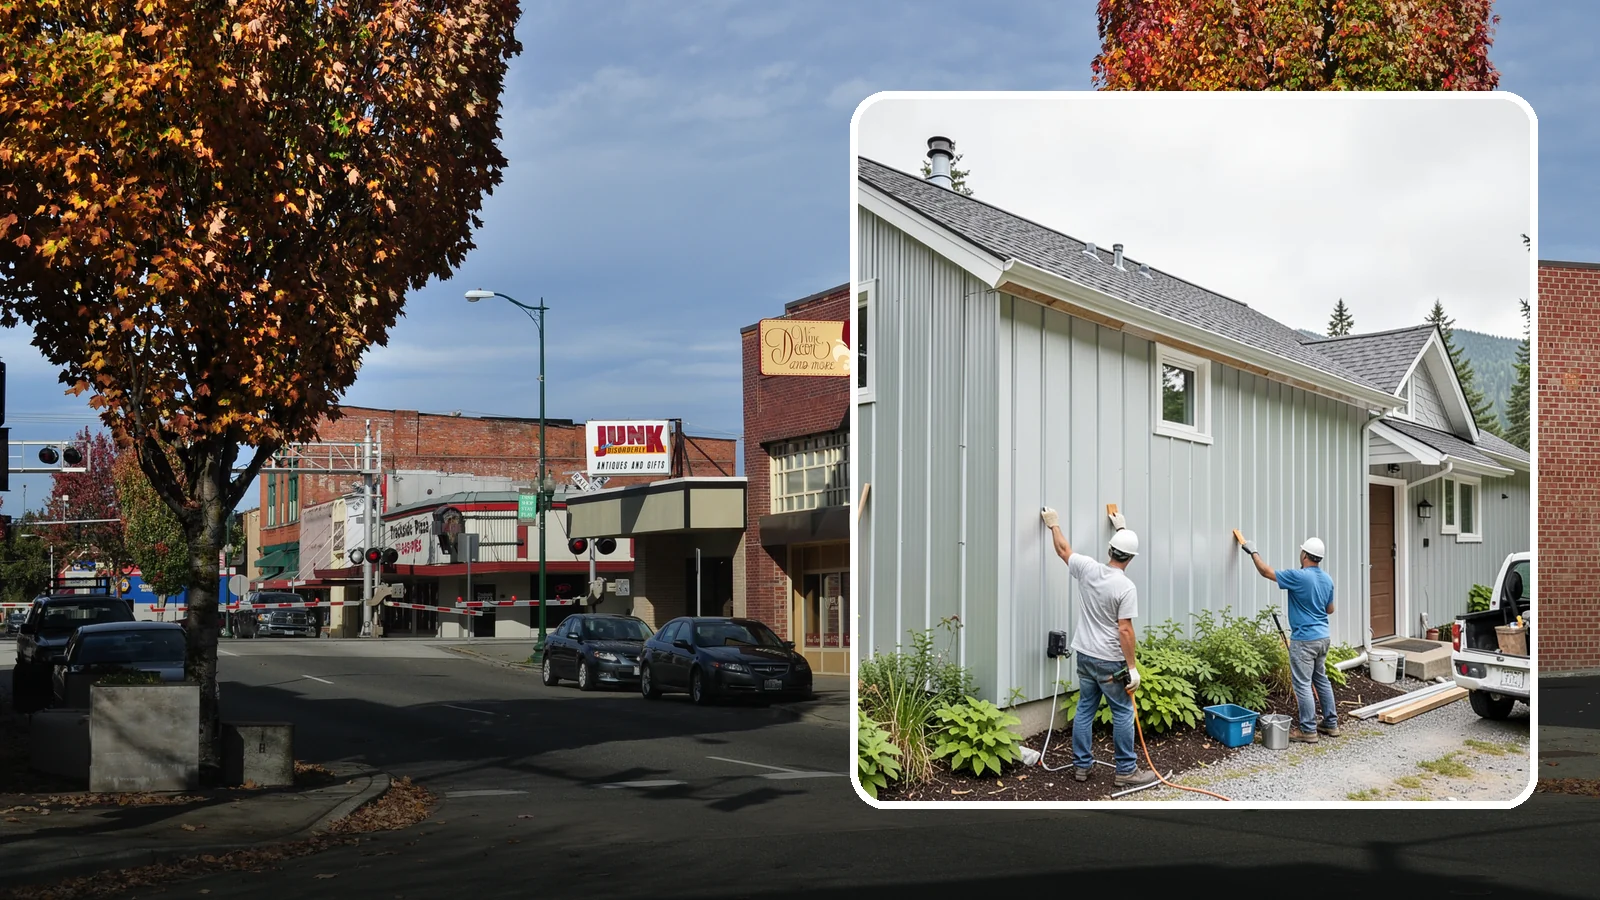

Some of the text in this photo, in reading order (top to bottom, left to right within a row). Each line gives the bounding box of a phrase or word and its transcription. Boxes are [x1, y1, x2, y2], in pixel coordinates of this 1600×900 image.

[596, 425, 664, 457] JUNK
[607, 446, 645, 454] DISORDERLY
[596, 460, 665, 470] ANTIQUES AND GIFTS
[414, 519, 429, 535] Pizza
